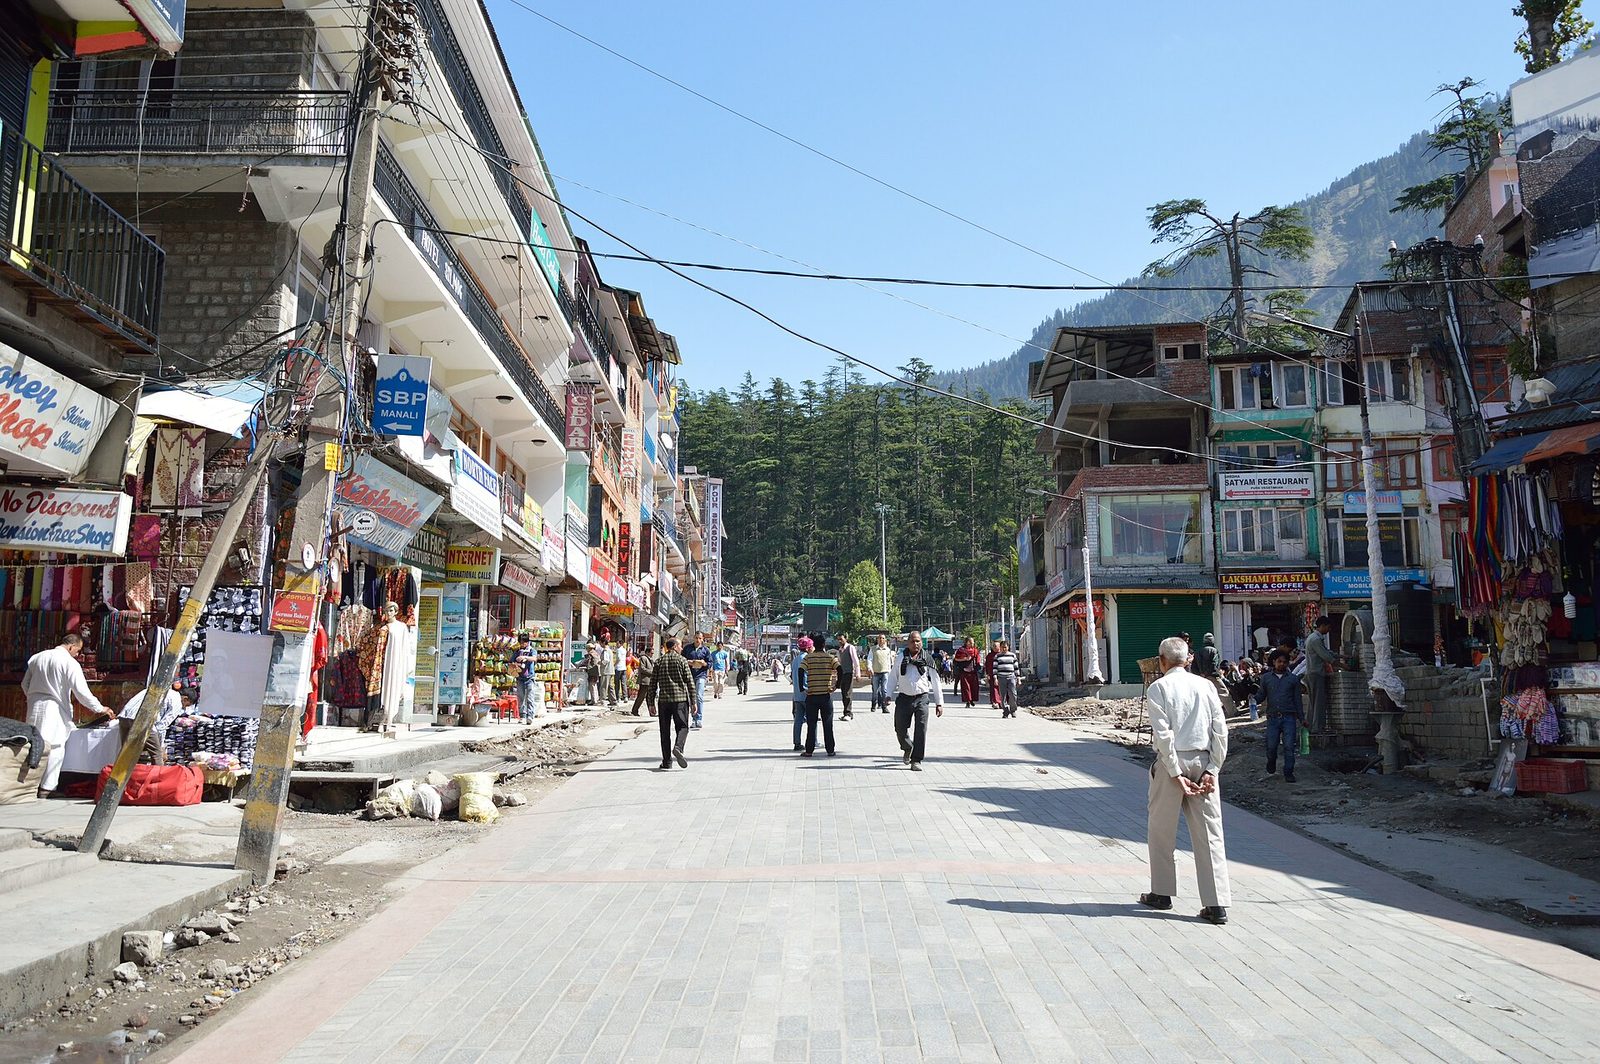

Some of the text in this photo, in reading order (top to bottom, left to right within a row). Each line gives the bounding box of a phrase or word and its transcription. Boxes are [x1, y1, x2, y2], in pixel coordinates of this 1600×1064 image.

[0, 366, 57, 413] oney
[378, 390, 426, 405] SBP
[381, 409, 418, 419] MANALI
[568, 395, 588, 448] CEDAR
[624, 434, 635, 473] RENUKA
[1, 489, 119, 519] No Discount
[336, 470, 421, 528] Kashmir
[75, 523, 114, 550] Shop
[431, 533, 446, 555] FACE
[710, 513, 718, 553] SEASONS
[478, 572, 491, 580] CALLS
[1222, 574, 1318, 583] LAKSHAMI TEA STALL
[275, 610, 309, 620] German Bakery
